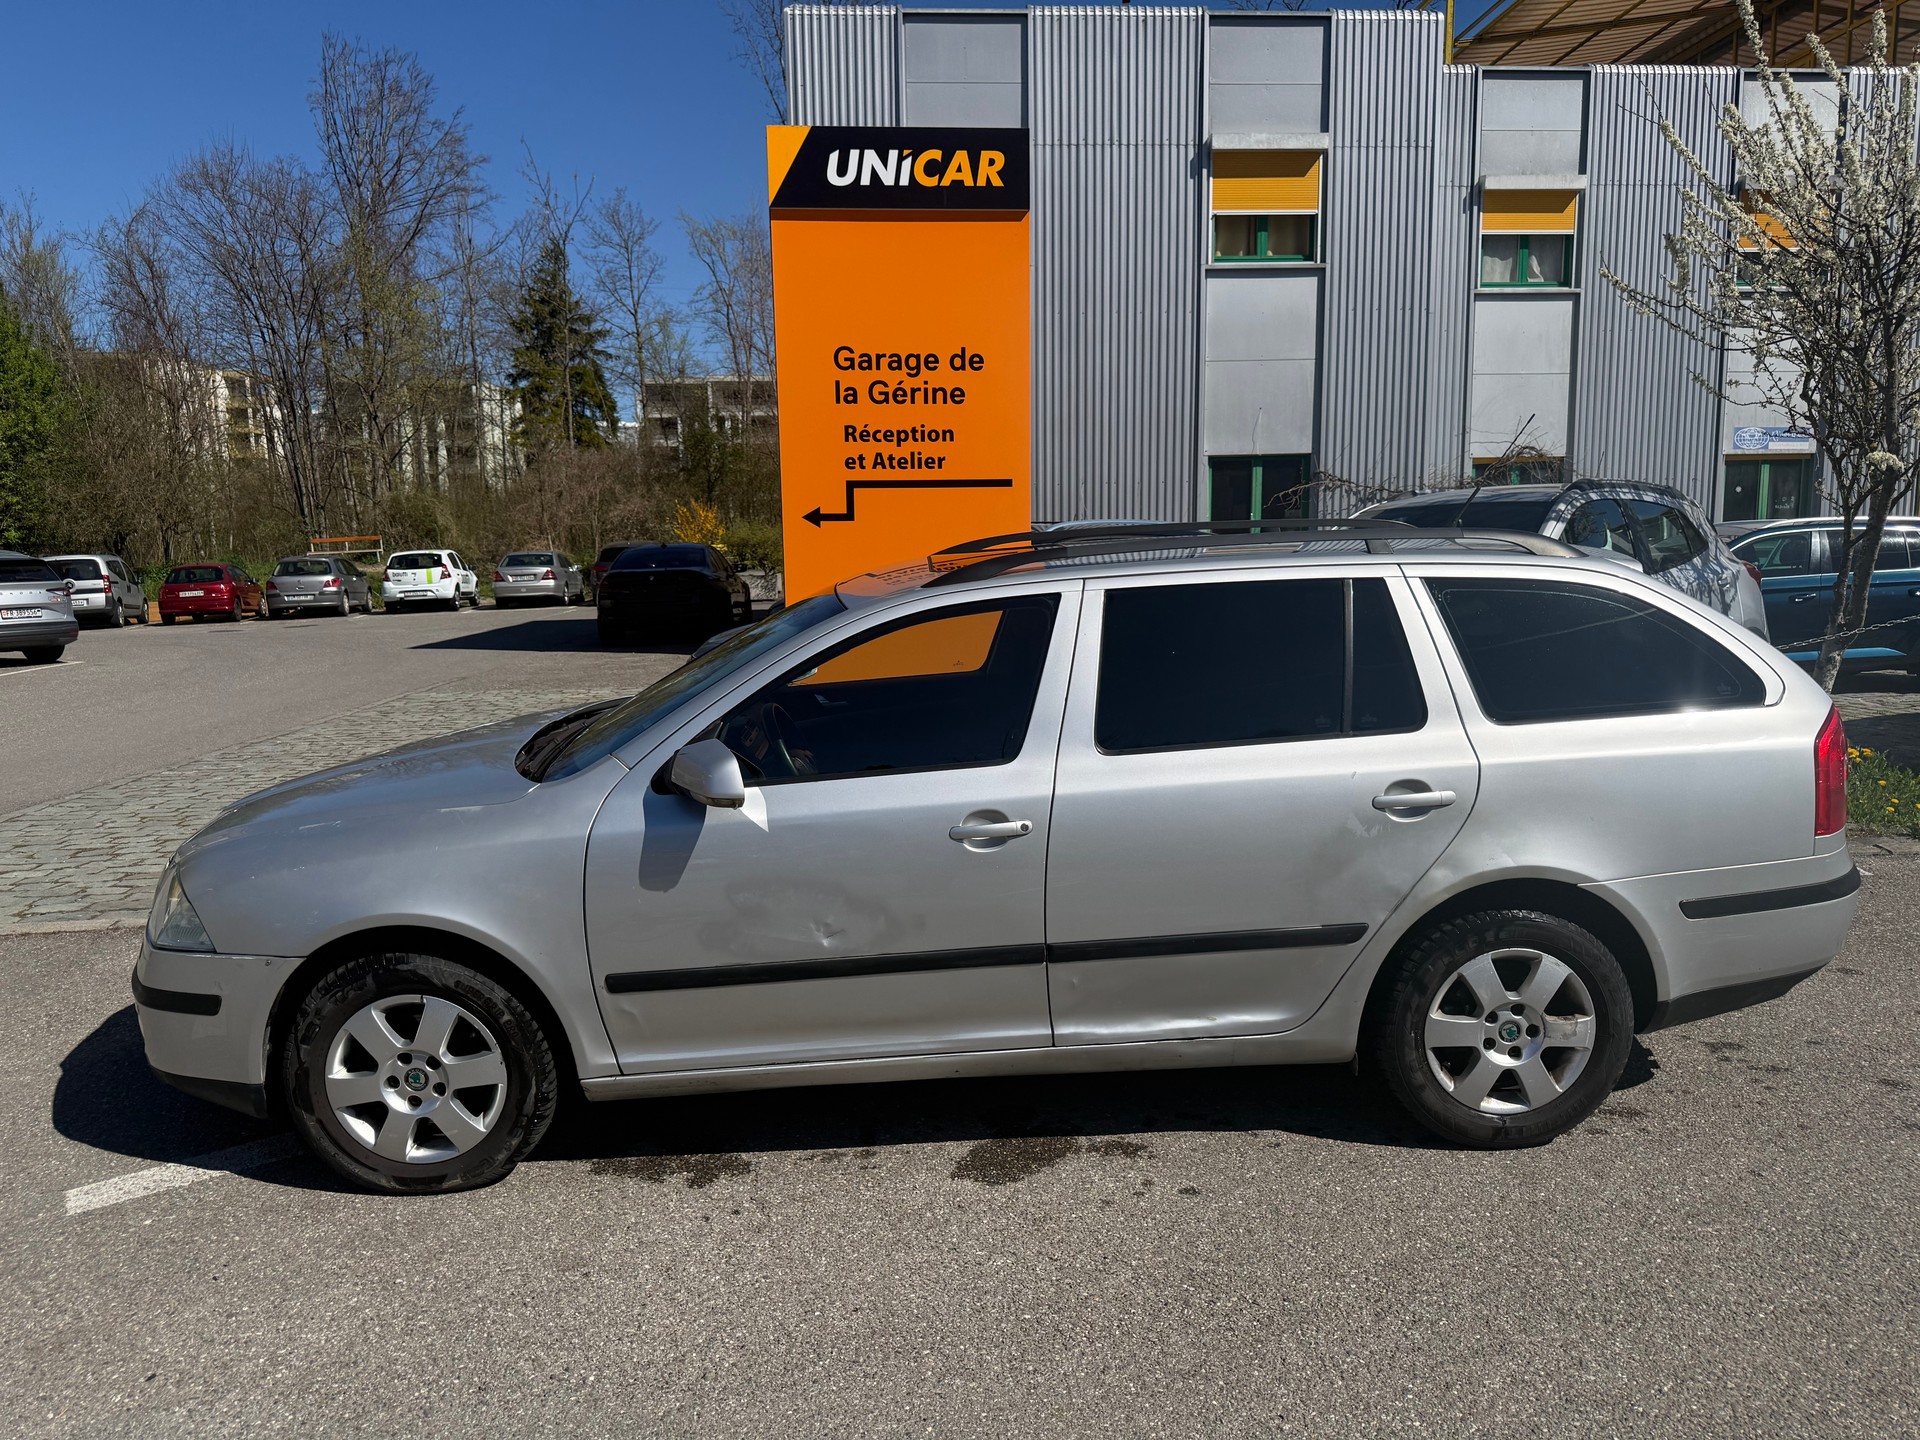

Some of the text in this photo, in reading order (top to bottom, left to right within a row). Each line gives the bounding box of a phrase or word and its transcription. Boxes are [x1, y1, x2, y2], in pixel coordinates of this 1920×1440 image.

[834, 346, 984, 378] Garage de
[834, 380, 965, 404] la Gérine
[844, 424, 954, 447] Réception
[845, 452, 945, 470] et Atelier
